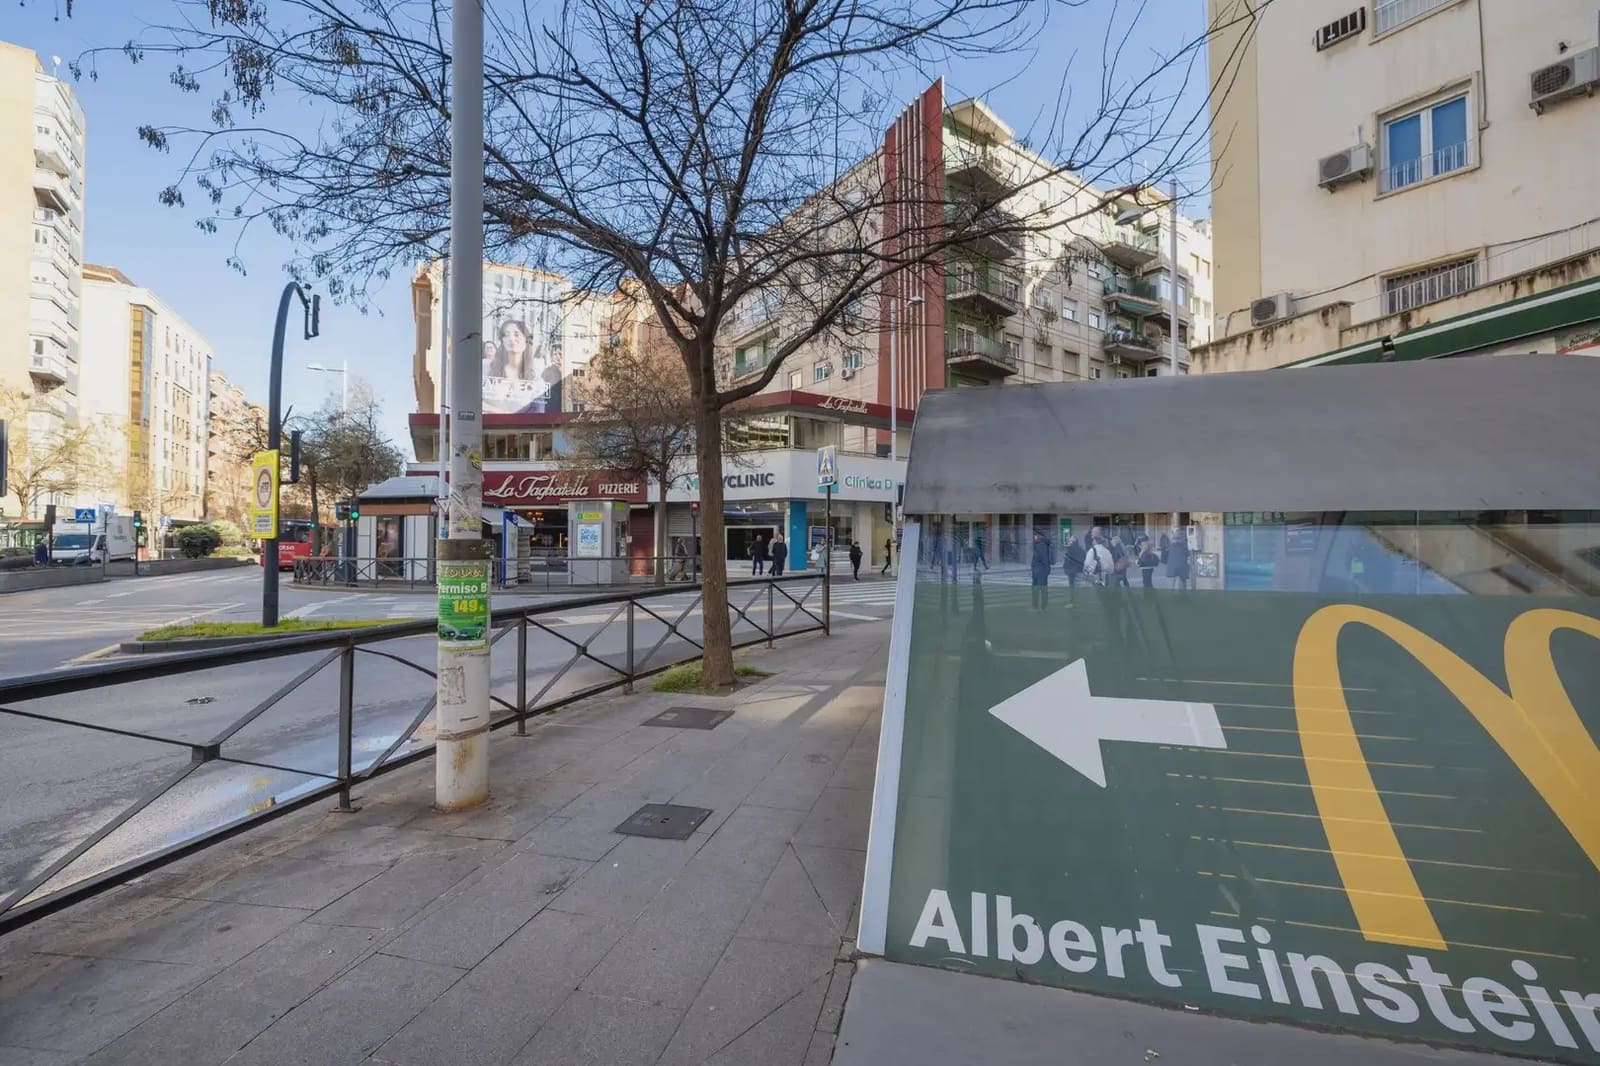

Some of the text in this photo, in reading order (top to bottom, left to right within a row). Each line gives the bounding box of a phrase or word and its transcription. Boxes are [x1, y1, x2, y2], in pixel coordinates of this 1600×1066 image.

[484, 475, 514, 497] La
[598, 482, 640, 495] PIZZERIE
[720, 473, 775, 489] YCLINIC
[844, 475, 883, 490] Clínica
[453, 599, 478, 614] 149
[908, 888, 1183, 989] Albert
